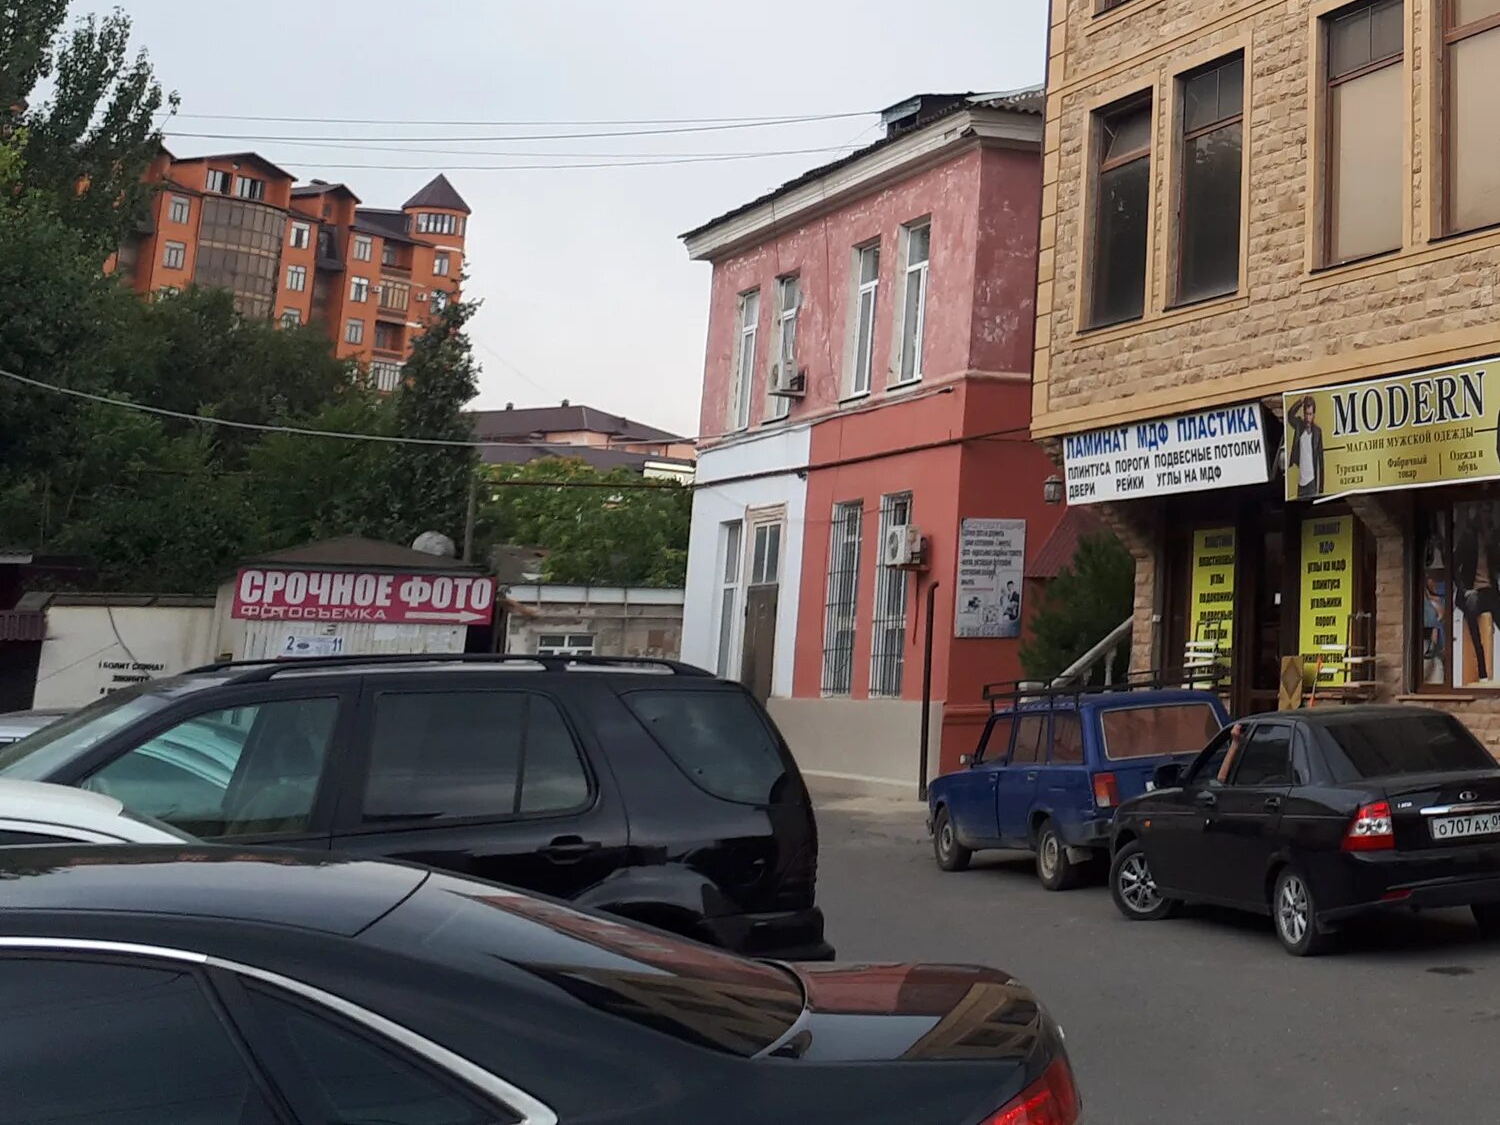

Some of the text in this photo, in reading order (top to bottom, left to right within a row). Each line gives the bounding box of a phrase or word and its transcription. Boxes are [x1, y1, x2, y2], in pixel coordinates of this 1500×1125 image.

[1332, 370, 1487, 436] MODERN
[1066, 406, 1259, 460] ЛАМИНАТ МДФ ПЛАСТИКА
[1346, 429, 1475, 453] МАГАЗИН МУЖСКОЙ ОДЕЖДЫ
[1068, 438, 1261, 480] ПЛИНТУСА ПОРОГИ ПОДВЕСНЫЕ ПОТОЛКИ
[1450, 450, 1476, 461] Одежда
[1457, 461, 1478, 475] обувь
[1068, 466, 1222, 501] ДВЕРИ РЕЙКИ УГЛЫ НА МДФ
[240, 570, 493, 610] СРОЧНОЕ ФОТО
[240, 604, 387, 621] ФОТОСЪЕМКА
